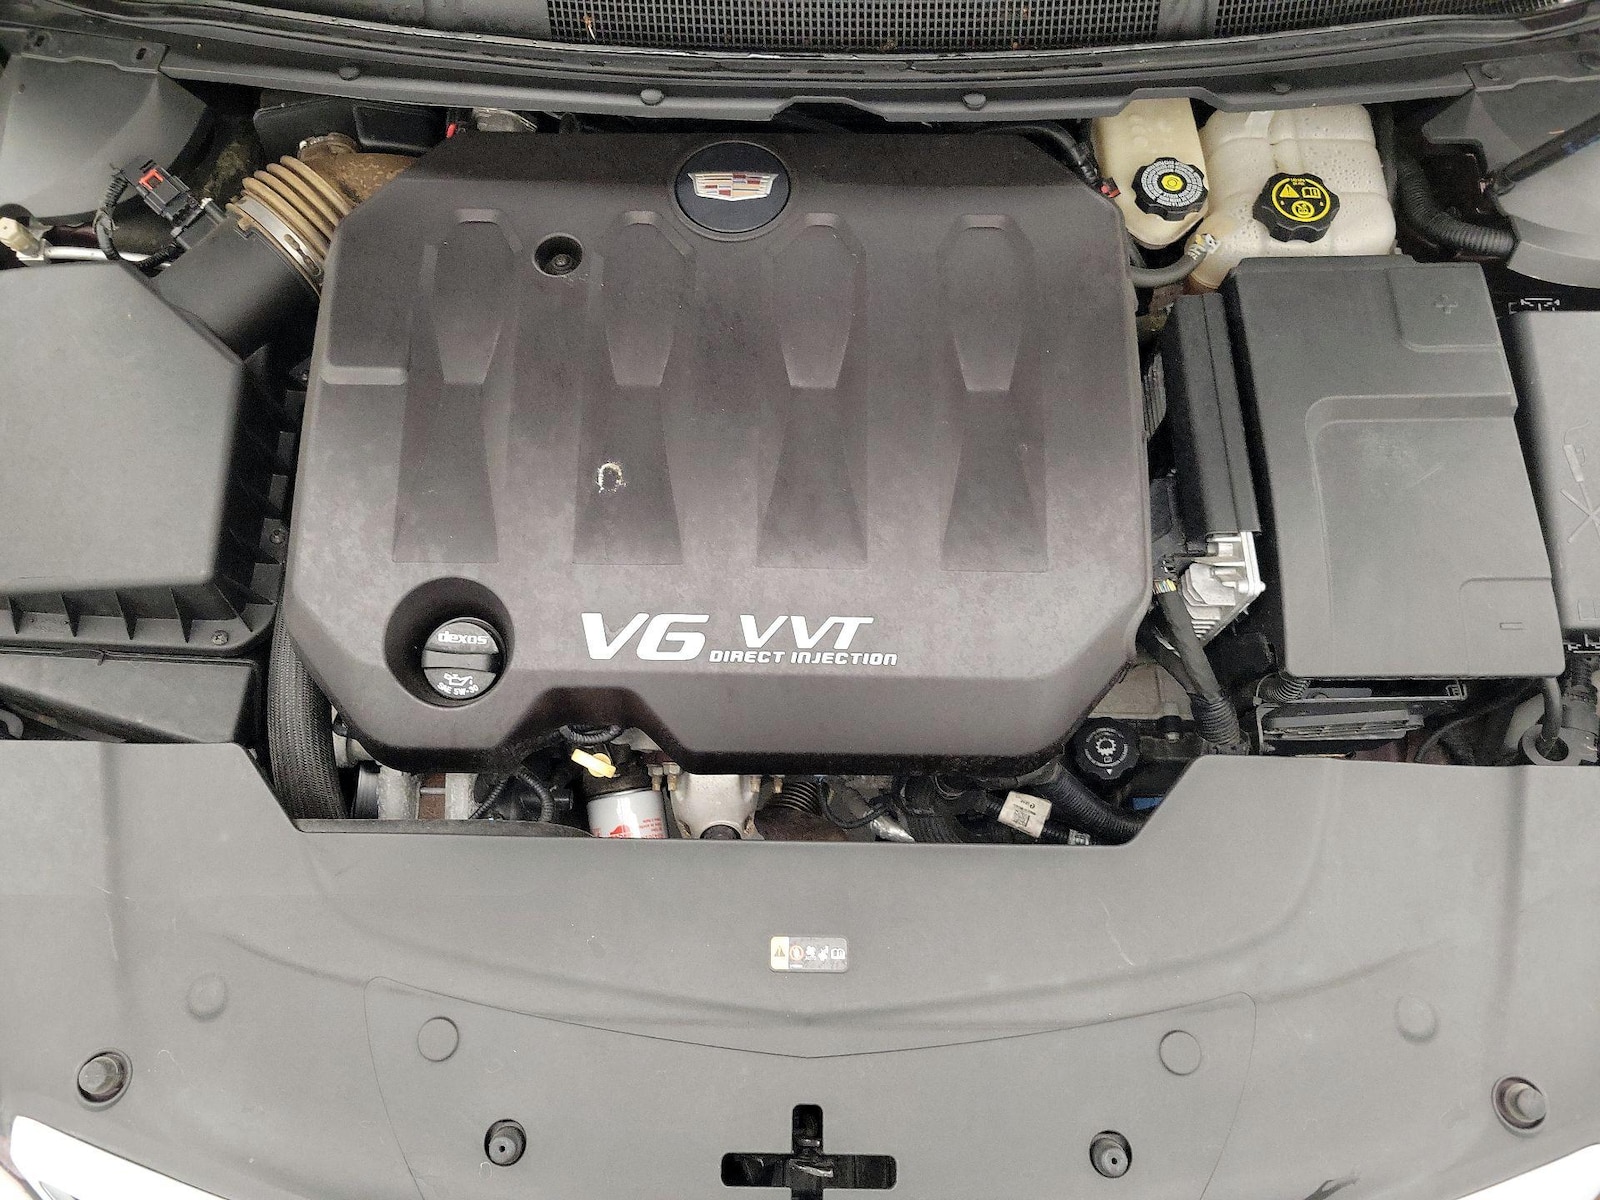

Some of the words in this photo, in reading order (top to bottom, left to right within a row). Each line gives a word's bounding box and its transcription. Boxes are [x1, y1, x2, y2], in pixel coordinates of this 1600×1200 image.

[437, 630, 488, 645] dexos
[581, 612, 710, 661] V6
[739, 614, 875, 650] VVT
[709, 650, 786, 664] DIRECT
[790, 652, 899, 666] INJECTION
[437, 682, 453, 694] SAE
[453, 684, 479, 696] 5W-30
